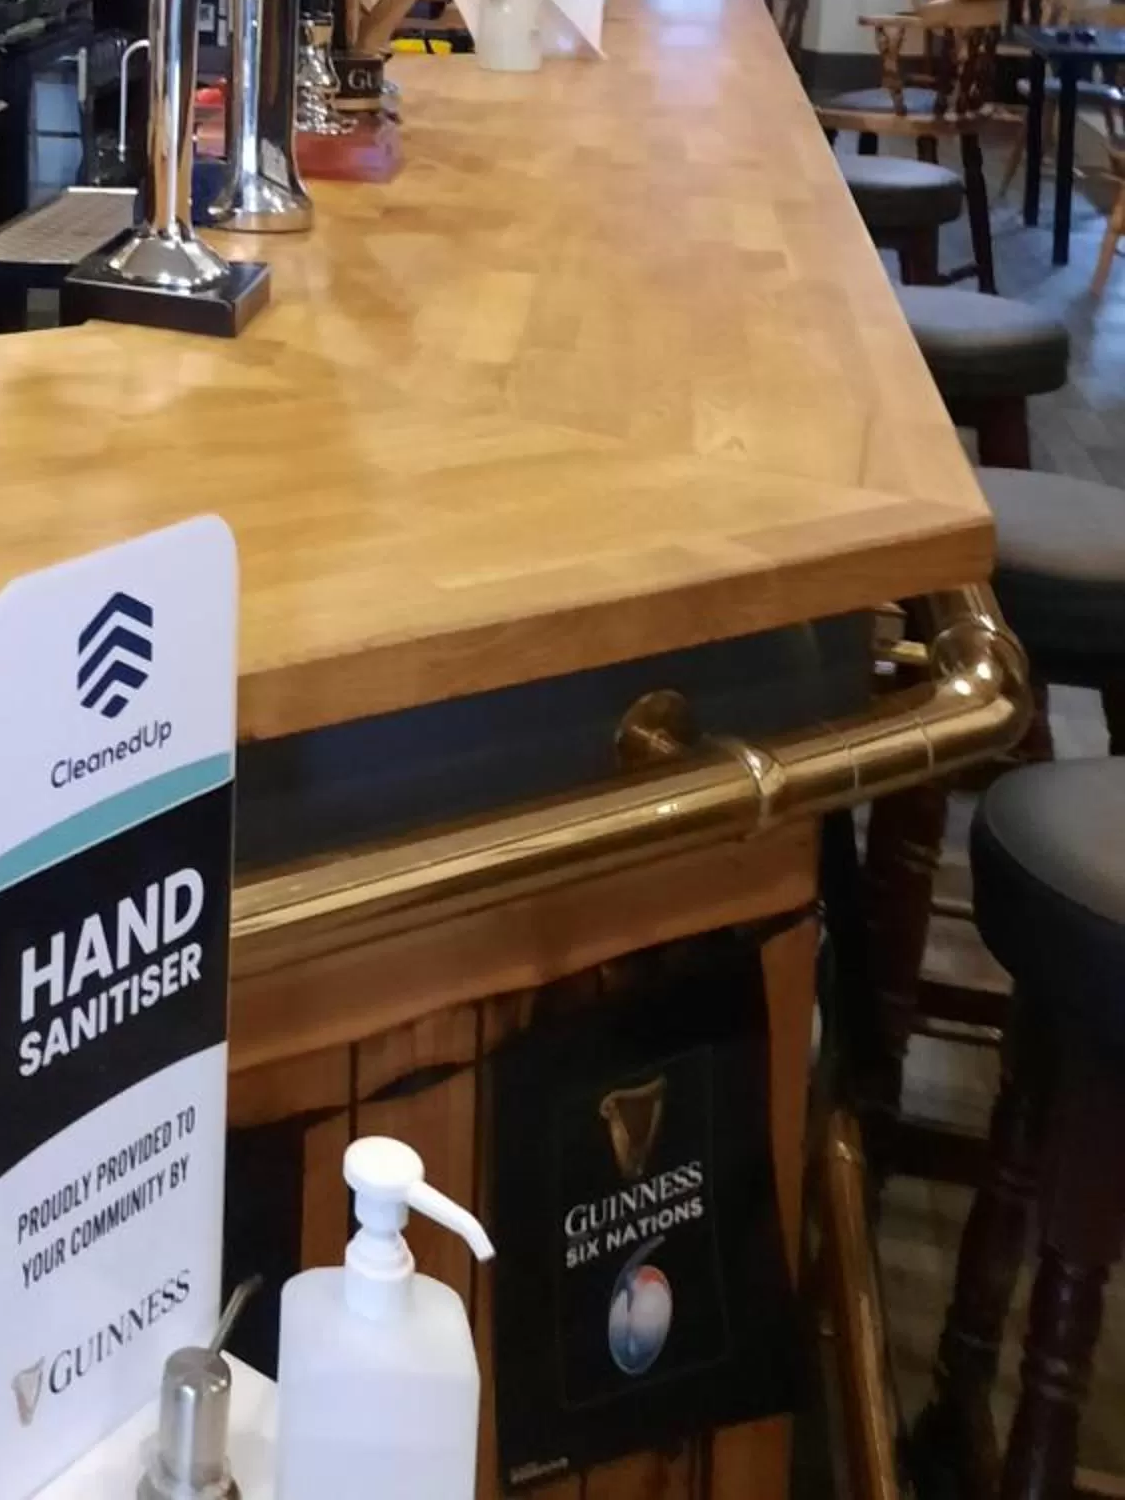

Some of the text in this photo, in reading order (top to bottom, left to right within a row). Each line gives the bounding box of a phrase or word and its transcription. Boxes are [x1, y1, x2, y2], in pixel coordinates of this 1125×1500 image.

[51, 718, 173, 789] CleanedUp
[17, 942, 204, 1078] SANITISER
[19, 866, 206, 1024] HAND
[17, 1104, 196, 1246] PROUDLY PROVIDED TO
[21, 1153, 190, 1291] YOUR COMMUNITY BY
[563, 1159, 704, 1238] GUINNESS
[565, 1195, 705, 1269] SIX NATIONS
[48, 1269, 192, 1396] GUINNESS
